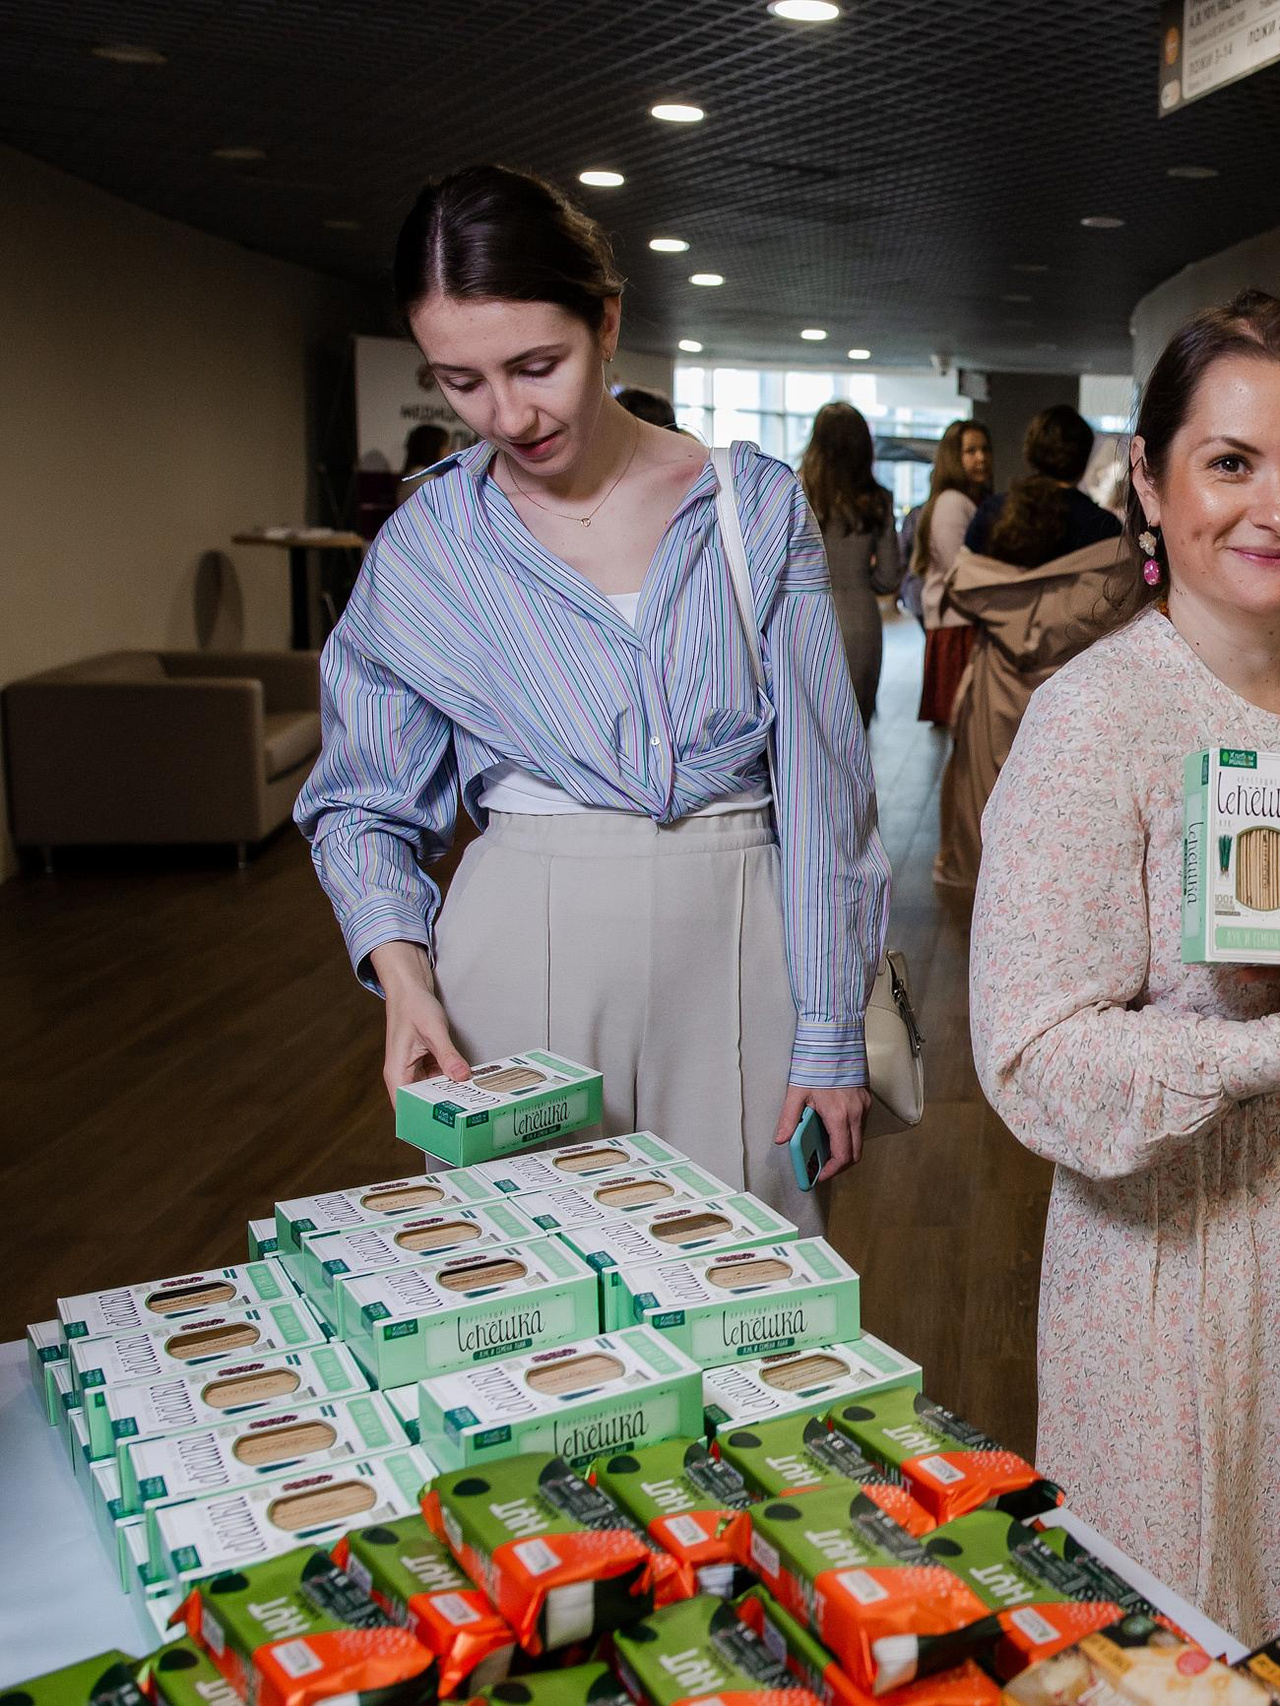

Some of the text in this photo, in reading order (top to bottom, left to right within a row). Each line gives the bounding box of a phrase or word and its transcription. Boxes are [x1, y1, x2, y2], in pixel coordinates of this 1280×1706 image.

[513, 1101, 570, 1136] Лепёшка
[457, 1310, 546, 1352] Лепёшка
[722, 1309, 808, 1347] Лепёшка
[553, 1410, 649, 1458] Лепёшка
